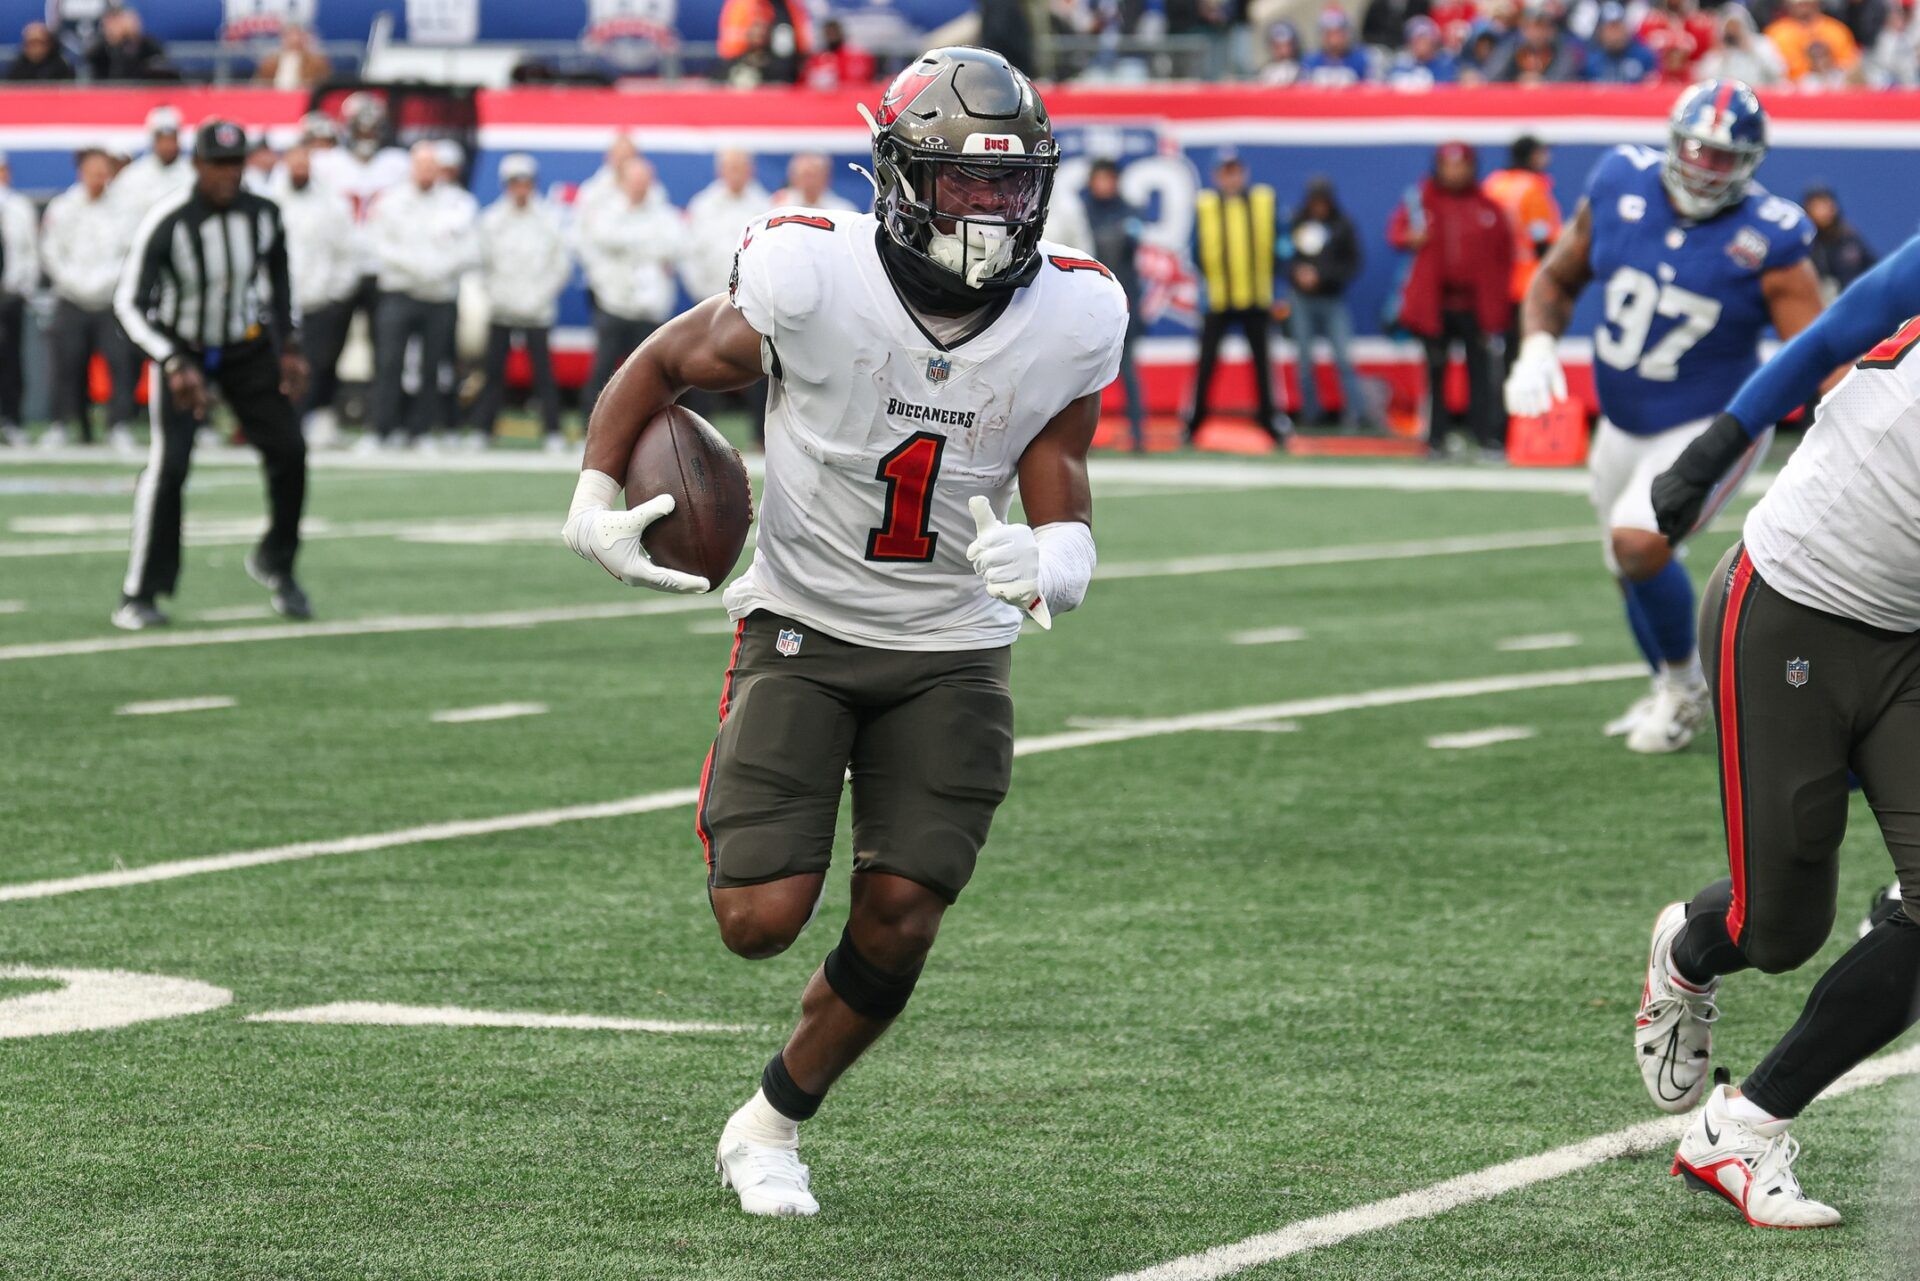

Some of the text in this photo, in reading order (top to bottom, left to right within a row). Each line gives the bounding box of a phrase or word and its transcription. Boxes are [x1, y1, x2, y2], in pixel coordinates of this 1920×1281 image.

[984, 137, 1010, 151] BUCS
[1595, 265, 1723, 381] 97
[886, 397, 976, 428] BUCCANEERS
[864, 430, 947, 562] 1
